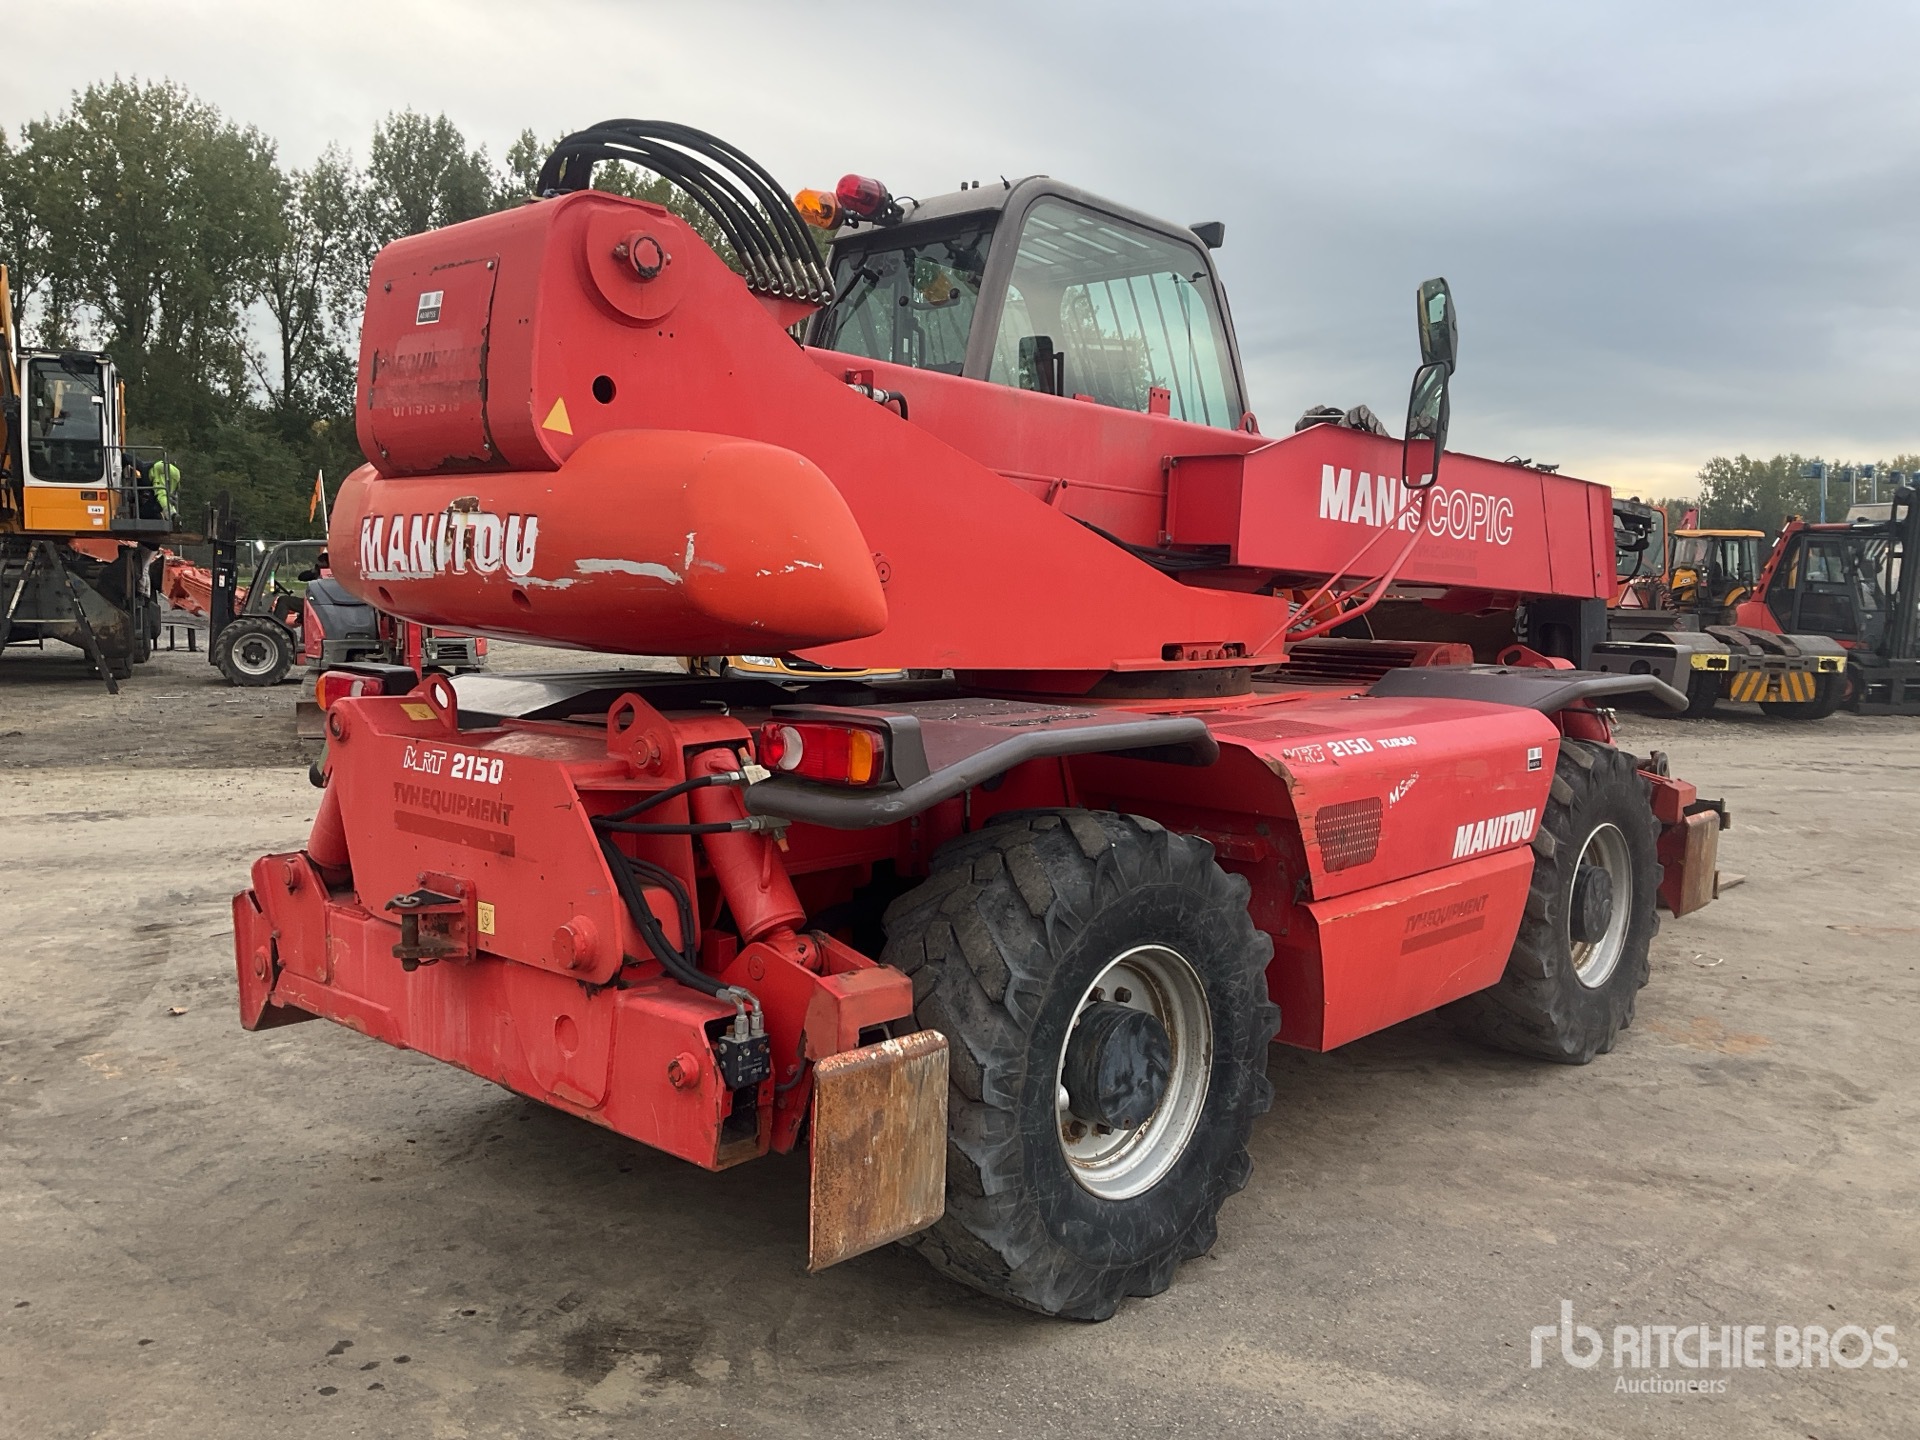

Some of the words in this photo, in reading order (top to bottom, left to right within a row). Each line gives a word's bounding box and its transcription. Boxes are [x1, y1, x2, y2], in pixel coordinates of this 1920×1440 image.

[360, 512, 539, 577] MANITOU
[403, 745, 447, 775] MRT
[450, 752, 504, 785] 2150
[1326, 737, 1375, 758] 2150
[1375, 735, 1418, 750] TURBO
[1452, 808, 1537, 860] MANITOU
